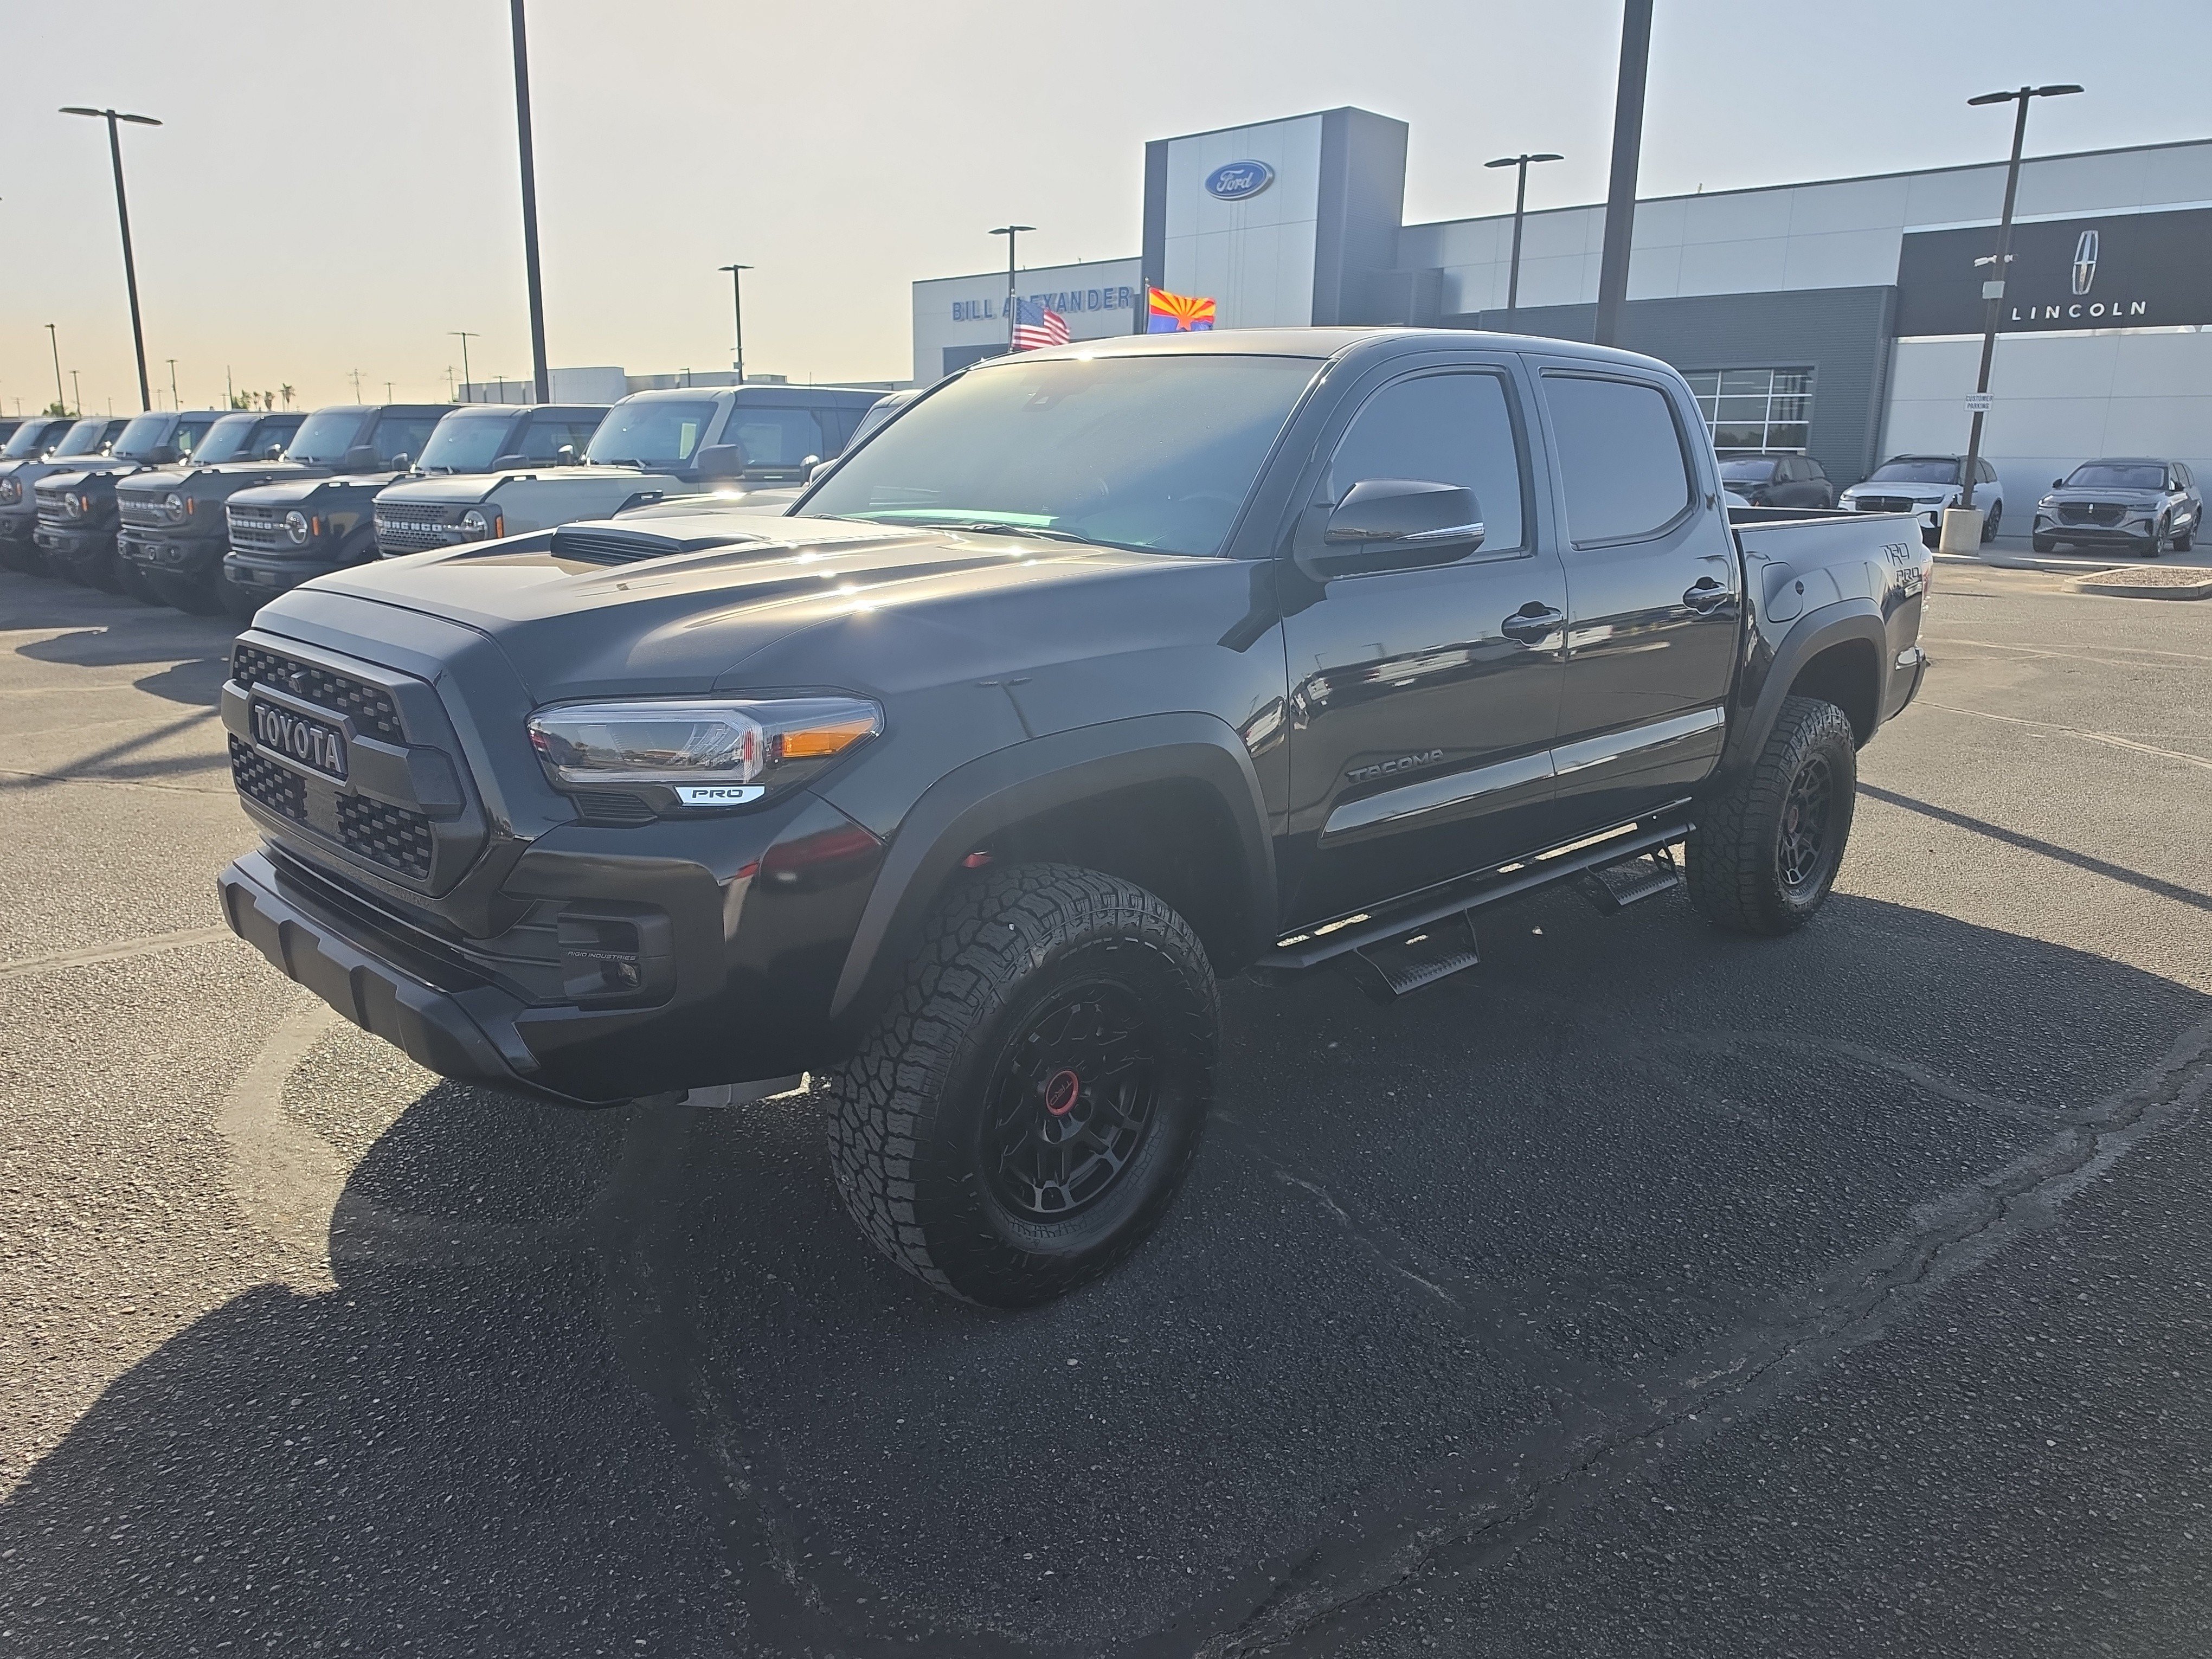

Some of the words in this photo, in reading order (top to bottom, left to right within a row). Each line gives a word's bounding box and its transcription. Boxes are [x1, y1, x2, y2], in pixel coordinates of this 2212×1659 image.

[1216, 169, 1255, 192] Ford
[953, 299, 994, 321] BILL
[1002, 286, 1131, 318] AEXANDER
[2012, 301, 2146, 320] LINCOLN
[383, 520, 442, 532] BRONCO
[1879, 543, 1909, 567] TRD
[1896, 567, 1920, 583] PRO
[254, 704, 343, 773] TOYOTA
[1347, 749, 1444, 782] TACOMA
[692, 789, 743, 799] PRO
[588, 953, 636, 961] INDUSTRIES
